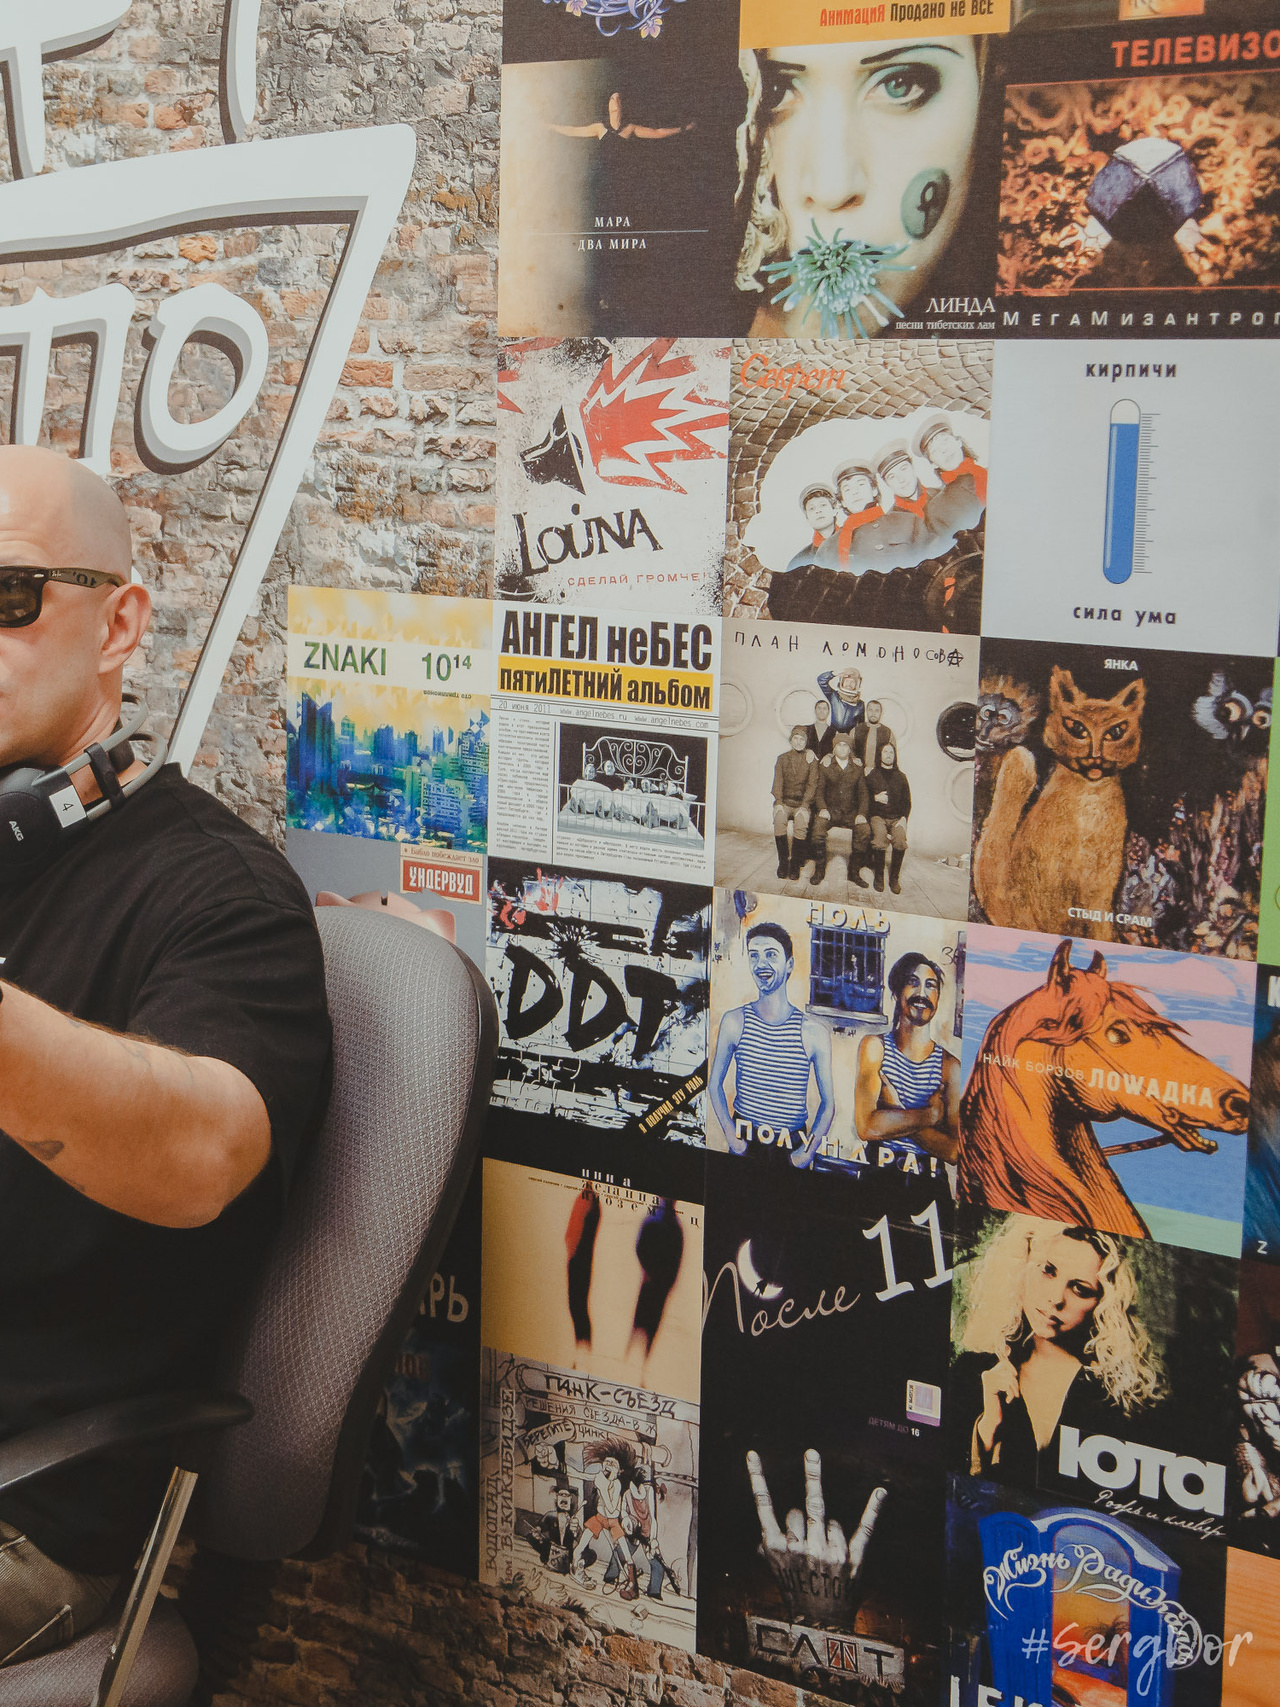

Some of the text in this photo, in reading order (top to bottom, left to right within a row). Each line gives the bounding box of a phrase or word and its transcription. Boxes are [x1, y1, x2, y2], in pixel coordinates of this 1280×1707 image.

[889, 1, 946, 22] Продано
[950, 3, 966, 17] не
[594, 216, 631, 227] МАРА
[577, 238, 647, 251] ДВА МИРА
[925, 297, 997, 317] ЛИНДА
[895, 319, 996, 331] песни тибетских лам
[1085, 362, 1178, 383] кирпичи
[567, 574, 629, 587] СДЕЛАЙ
[1072, 606, 1178, 628] сила ума
[501, 610, 713, 671] АНГЕЛ неБЕС
[734, 631, 799, 652] ПЛАН
[303, 641, 386, 676] ZNAKI
[1103, 658, 1139, 672] ЯНКА
[500, 667, 711, 710] пятиЛЕТНИЙ альбом
[498, 700, 508, 710] 20
[533, 704, 551, 714] 2011
[62, 803, 74, 812] 4
[9, 820, 24, 842] AKG
[409, 866, 474, 896] УНДЕРВУД
[806, 901, 891, 934] НОЛЬ
[1067, 906, 1153, 928] СТЫД И СРАМ
[502, 943, 678, 1060] DDT
[982, 1053, 1021, 1070] НАЙК
[1025, 1061, 1085, 1081] БОРЗОВ
[672, 1089, 687, 1105] ЭТУ
[684, 1075, 704, 1094] РОЛЬ
[862, 1199, 953, 1302] 11
[910, 1427, 920, 1438] 16
